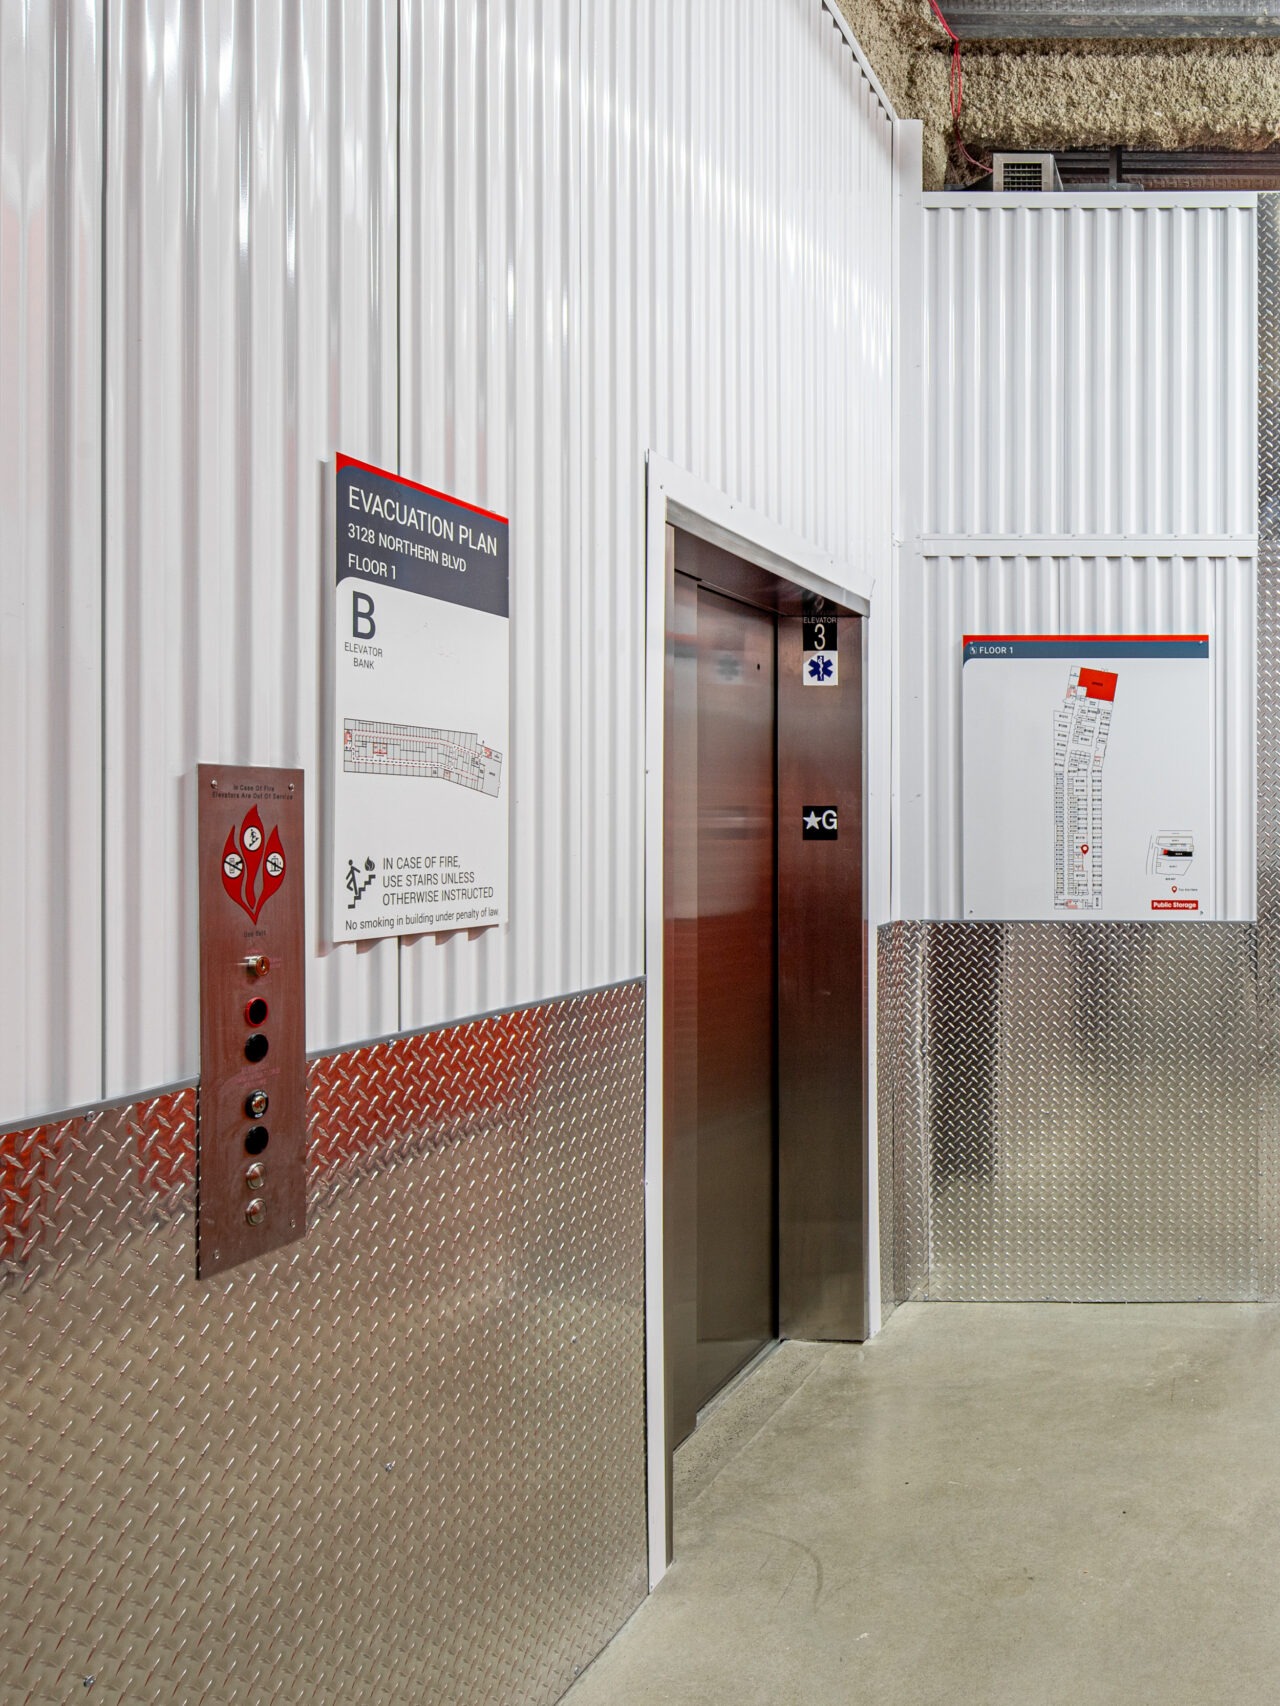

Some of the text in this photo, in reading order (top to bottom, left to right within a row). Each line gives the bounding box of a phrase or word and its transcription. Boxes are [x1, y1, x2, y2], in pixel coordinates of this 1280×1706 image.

[349, 485, 497, 556] EVACUATION PLAN
[348, 523, 466, 572] 3128 NORTHERN BLVD
[348, 553, 396, 580] FLOOR 1
[352, 590, 376, 640] B
[803, 616, 838, 624] ELEVATOR
[814, 623, 826, 650] 3
[344, 641, 383, 658] ELEVATOR
[979, 646, 1014, 655] FLOOR 1
[353, 657, 375, 670] BANK
[212, 791, 240, 799] Elevators
[272, 793, 293, 801] Service
[821, 810, 838, 830] G
[383, 855, 461, 870] IN CASE OF FIRE,
[383, 872, 475, 888] USE STAIRS UNLESS
[383, 887, 494, 906] OTHERWISE INSTRUCTED
[1173, 902, 1197, 910] Storage
[345, 907, 498, 931] No smoking in building under penalty of law
